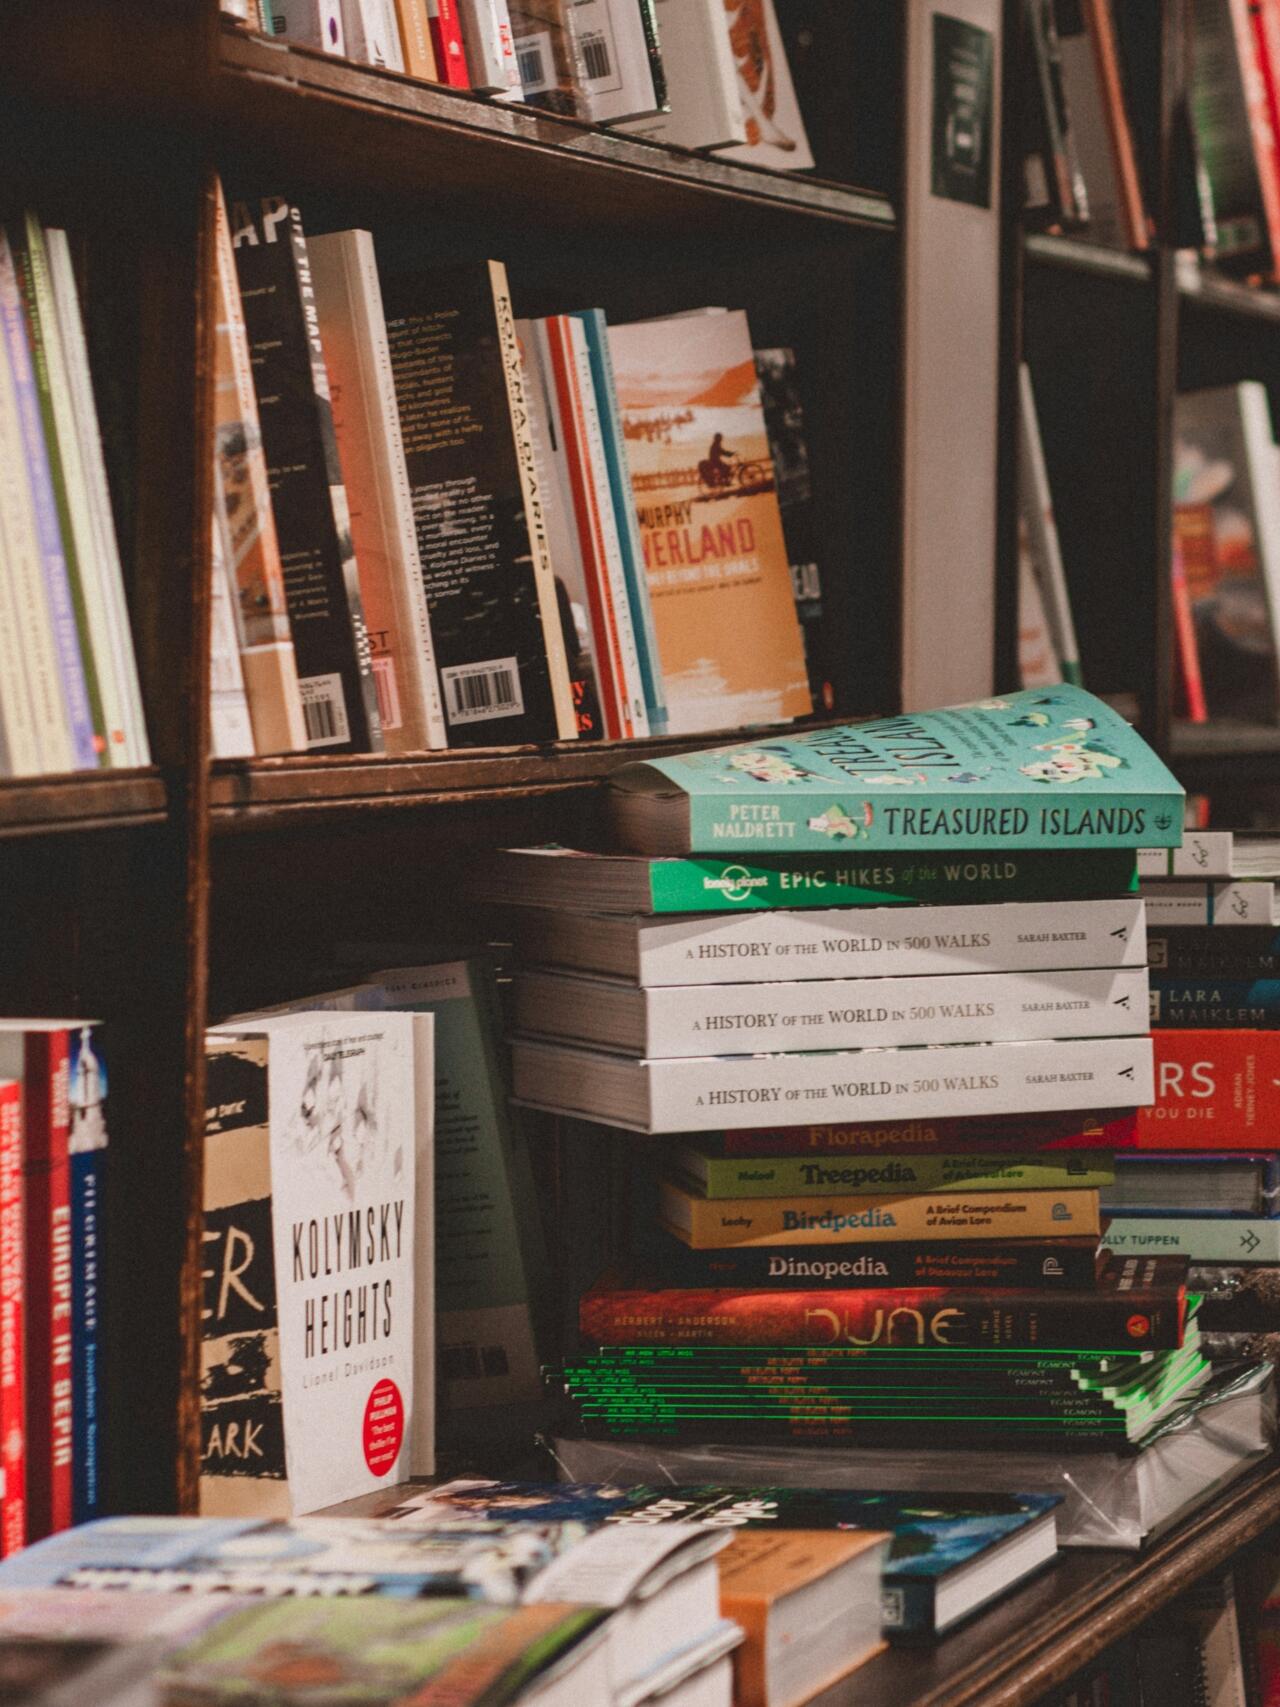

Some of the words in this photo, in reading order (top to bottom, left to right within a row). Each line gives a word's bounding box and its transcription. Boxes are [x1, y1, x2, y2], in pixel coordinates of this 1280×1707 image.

[297, 257, 315, 298] THE
[304, 305, 322, 353] MAP
[637, 502, 693, 529] MURPHY
[729, 804, 781, 821] PETER
[884, 808, 1029, 835] TREASURED
[1041, 808, 1146, 835] ISLANDS
[712, 821, 797, 839] NALDRETT
[703, 876, 735, 892] lonely
[735, 875, 769, 890] planet
[779, 871, 827, 889] EPIC
[836, 867, 896, 886] HIKES
[902, 865, 915, 885] of
[918, 864, 937, 881] the
[944, 863, 1018, 882] WORLD
[686, 949, 694, 959] A
[699, 942, 772, 959] HISTORY
[776, 945, 792, 956] OF
[793, 943, 818, 955] THE
[823, 937, 883, 953] WORLD
[887, 940, 900, 951] IN
[904, 936, 931, 950] 500
[934, 933, 991, 948] WALKS
[1017, 933, 1050, 943] SARAH
[1051, 931, 1087, 942] BAXTER
[1021, 1002, 1053, 1012] SARAH
[1055, 1000, 1090, 1011] BAXTER
[1169, 989, 1222, 1003] LARA
[692, 1021, 701, 1031] A
[706, 1013, 778, 1030] HISTORY
[782, 1016, 797, 1027] OF
[800, 1014, 824, 1025] THE
[828, 1008, 888, 1023] WORLD
[892, 1010, 907, 1021] IN
[909, 1006, 935, 1020] 500
[939, 1003, 995, 1018] WALKS
[1170, 1008, 1266, 1021] MAIKLEM
[696, 1096, 705, 1106] A
[709, 1087, 782, 1106] HISTORY
[785, 1091, 801, 1101] OF
[803, 1088, 828, 1099] THE
[831, 1081, 892, 1097] WORLD
[895, 1084, 909, 1094] IN
[913, 1079, 939, 1094] 500
[943, 1076, 999, 1091] WALKS
[1025, 1074, 1058, 1084] SARAH
[1059, 1072, 1094, 1083] BAXTER
[1159, 1062, 1216, 1098] RS
[1234, 1073, 1242, 1109] ADRIAN
[1144, 1107, 1179, 1119] YOU
[1187, 1107, 1215, 1119] DIE
[808, 1123, 939, 1147] Florapedia
[800, 1161, 918, 1187] Treepedia
[782, 1207, 897, 1233] Birdpedia
[926, 1205, 934, 1215] A
[936, 1204, 961, 1215] Brief
[962, 1202, 1027, 1216] Compendium
[926, 1216, 937, 1226] of
[938, 1216, 968, 1226] Avian
[969, 1216, 992, 1226] Lore
[293, 1200, 404, 1283] KOLYMSKY
[1131, 1234, 1180, 1246] TUPPEN
[53, 1204, 73, 1319] EUROPE
[768, 1254, 889, 1280] Dinopedia
[305, 1279, 392, 1359] HEIGHTS
[614, 1316, 664, 1326] HERBERT
[678, 1316, 737, 1326] ANDERSON
[805, 1307, 969, 1346] DUNE
[53, 1334, 73, 1366] IN
[304, 1369, 339, 1389] Lionel
[345, 1354, 395, 1378] Davidson
[1007, 1369, 1046, 1377] EGMONT
[1015, 1378, 1053, 1386] EGMONT
[201, 1419, 264, 1458] ARK
